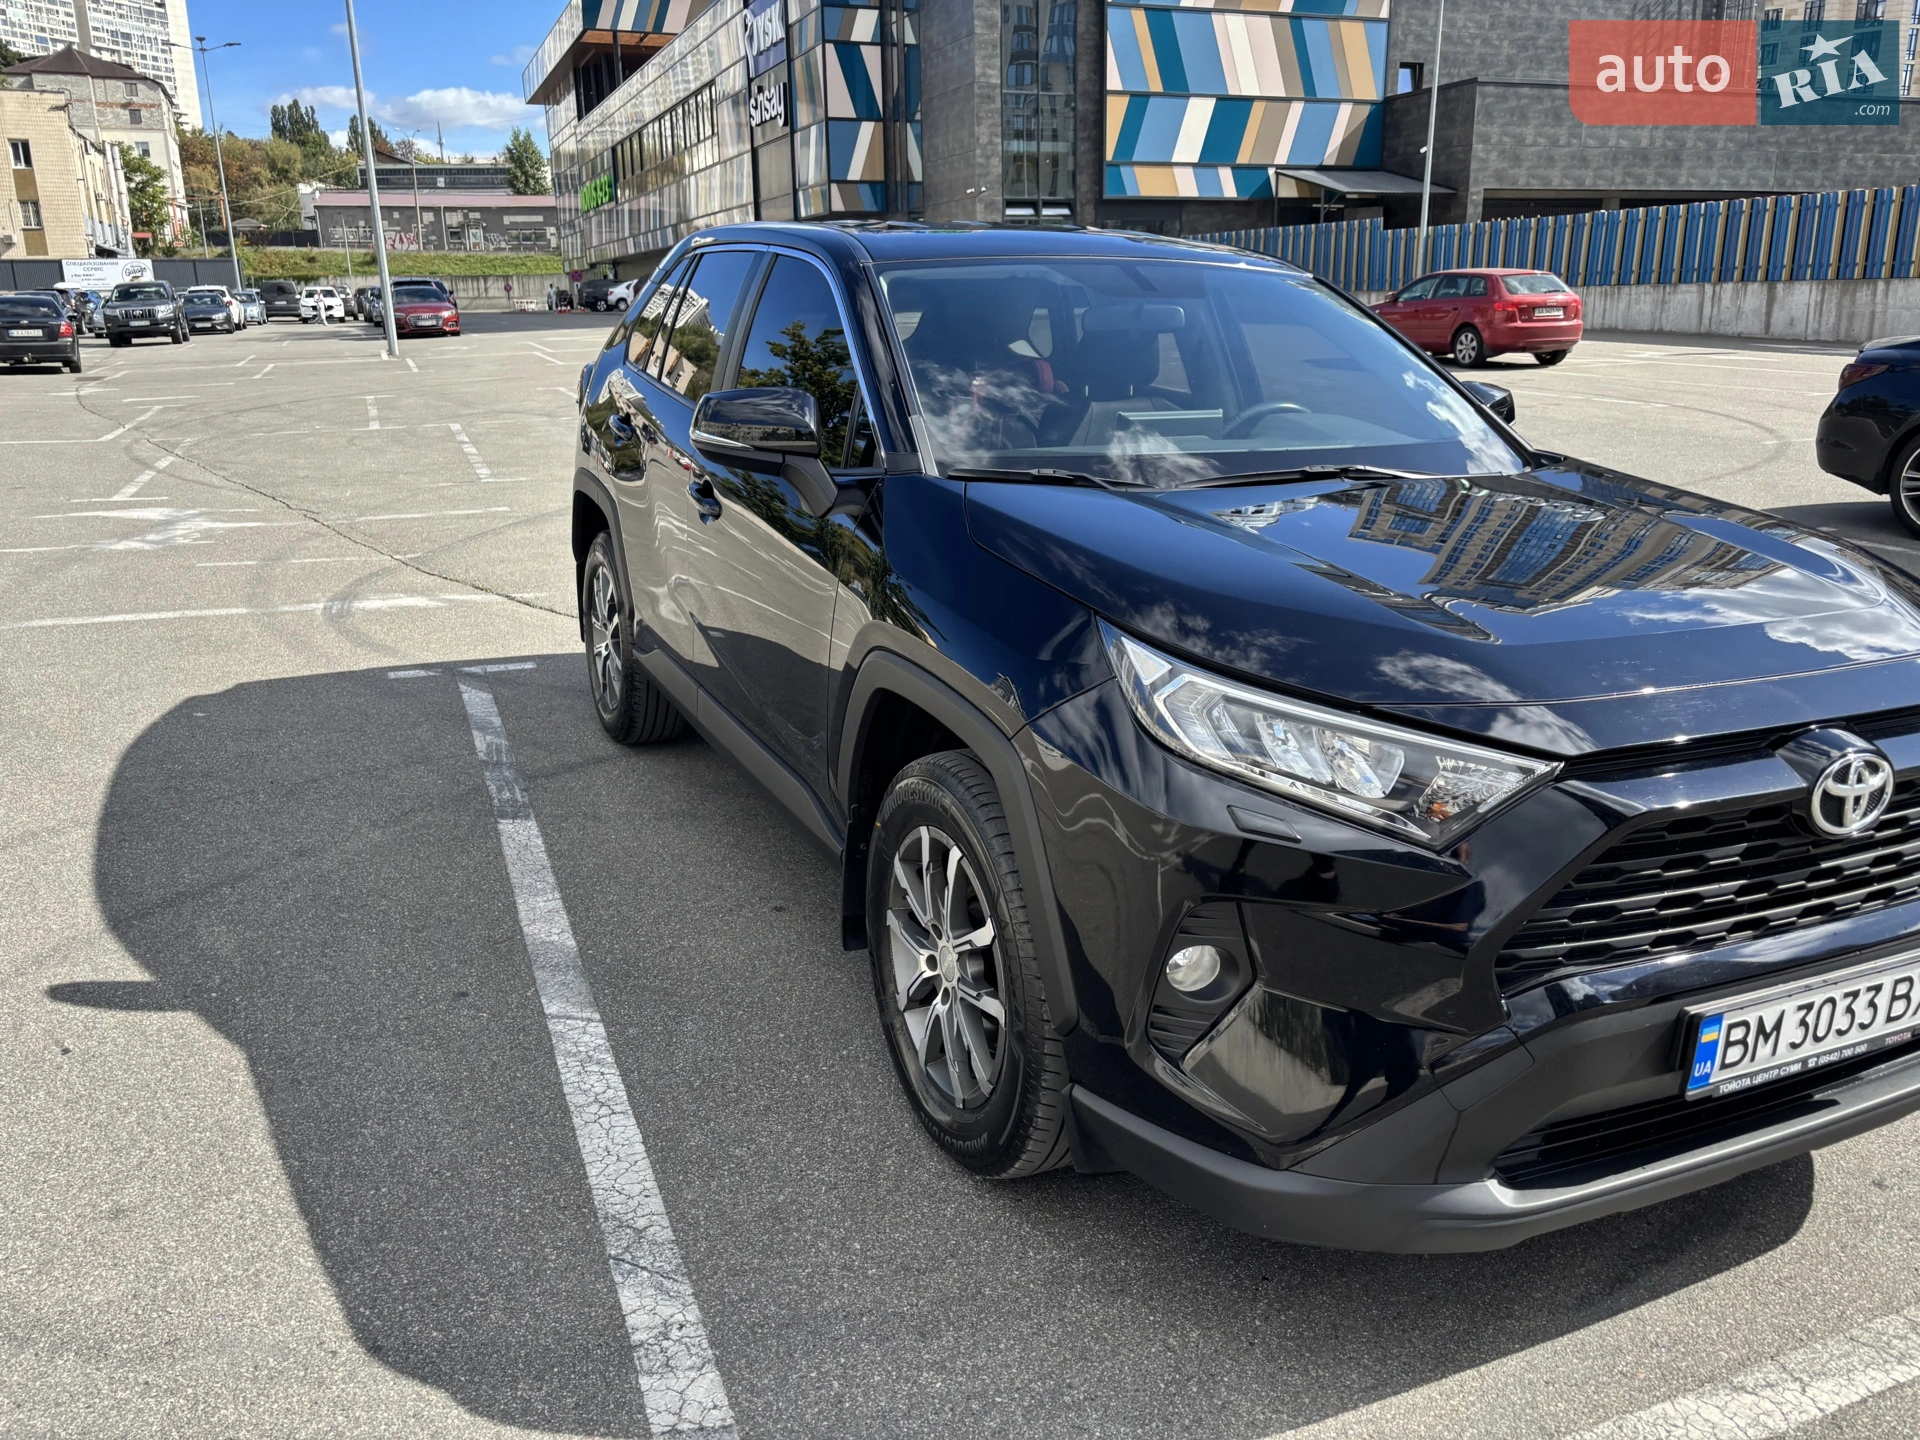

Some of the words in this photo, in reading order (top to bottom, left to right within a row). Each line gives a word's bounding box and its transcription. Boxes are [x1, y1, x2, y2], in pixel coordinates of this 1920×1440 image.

[752, 1, 785, 56] JYSK
[750, 82, 785, 127] sinsay
[125, 266, 147, 277] Garage
[1719, 1009, 1786, 1071] BM
[1789, 982, 1884, 1050] 3033
[1885, 975, 1920, 1024] B
[1885, 1031, 1912, 1045] TOYOTA
[1694, 1059, 1711, 1077] UA
[1719, 1077, 1751, 1094] ТОЙОТА
[1752, 1069, 1779, 1084] ЦЕНТР
[1780, 1061, 1802, 1076] СУМИ
[1818, 1050, 1840, 1065] (0542)
[1841, 1047, 1854, 1058] 700
[1854, 1043, 1868, 1054] 500
